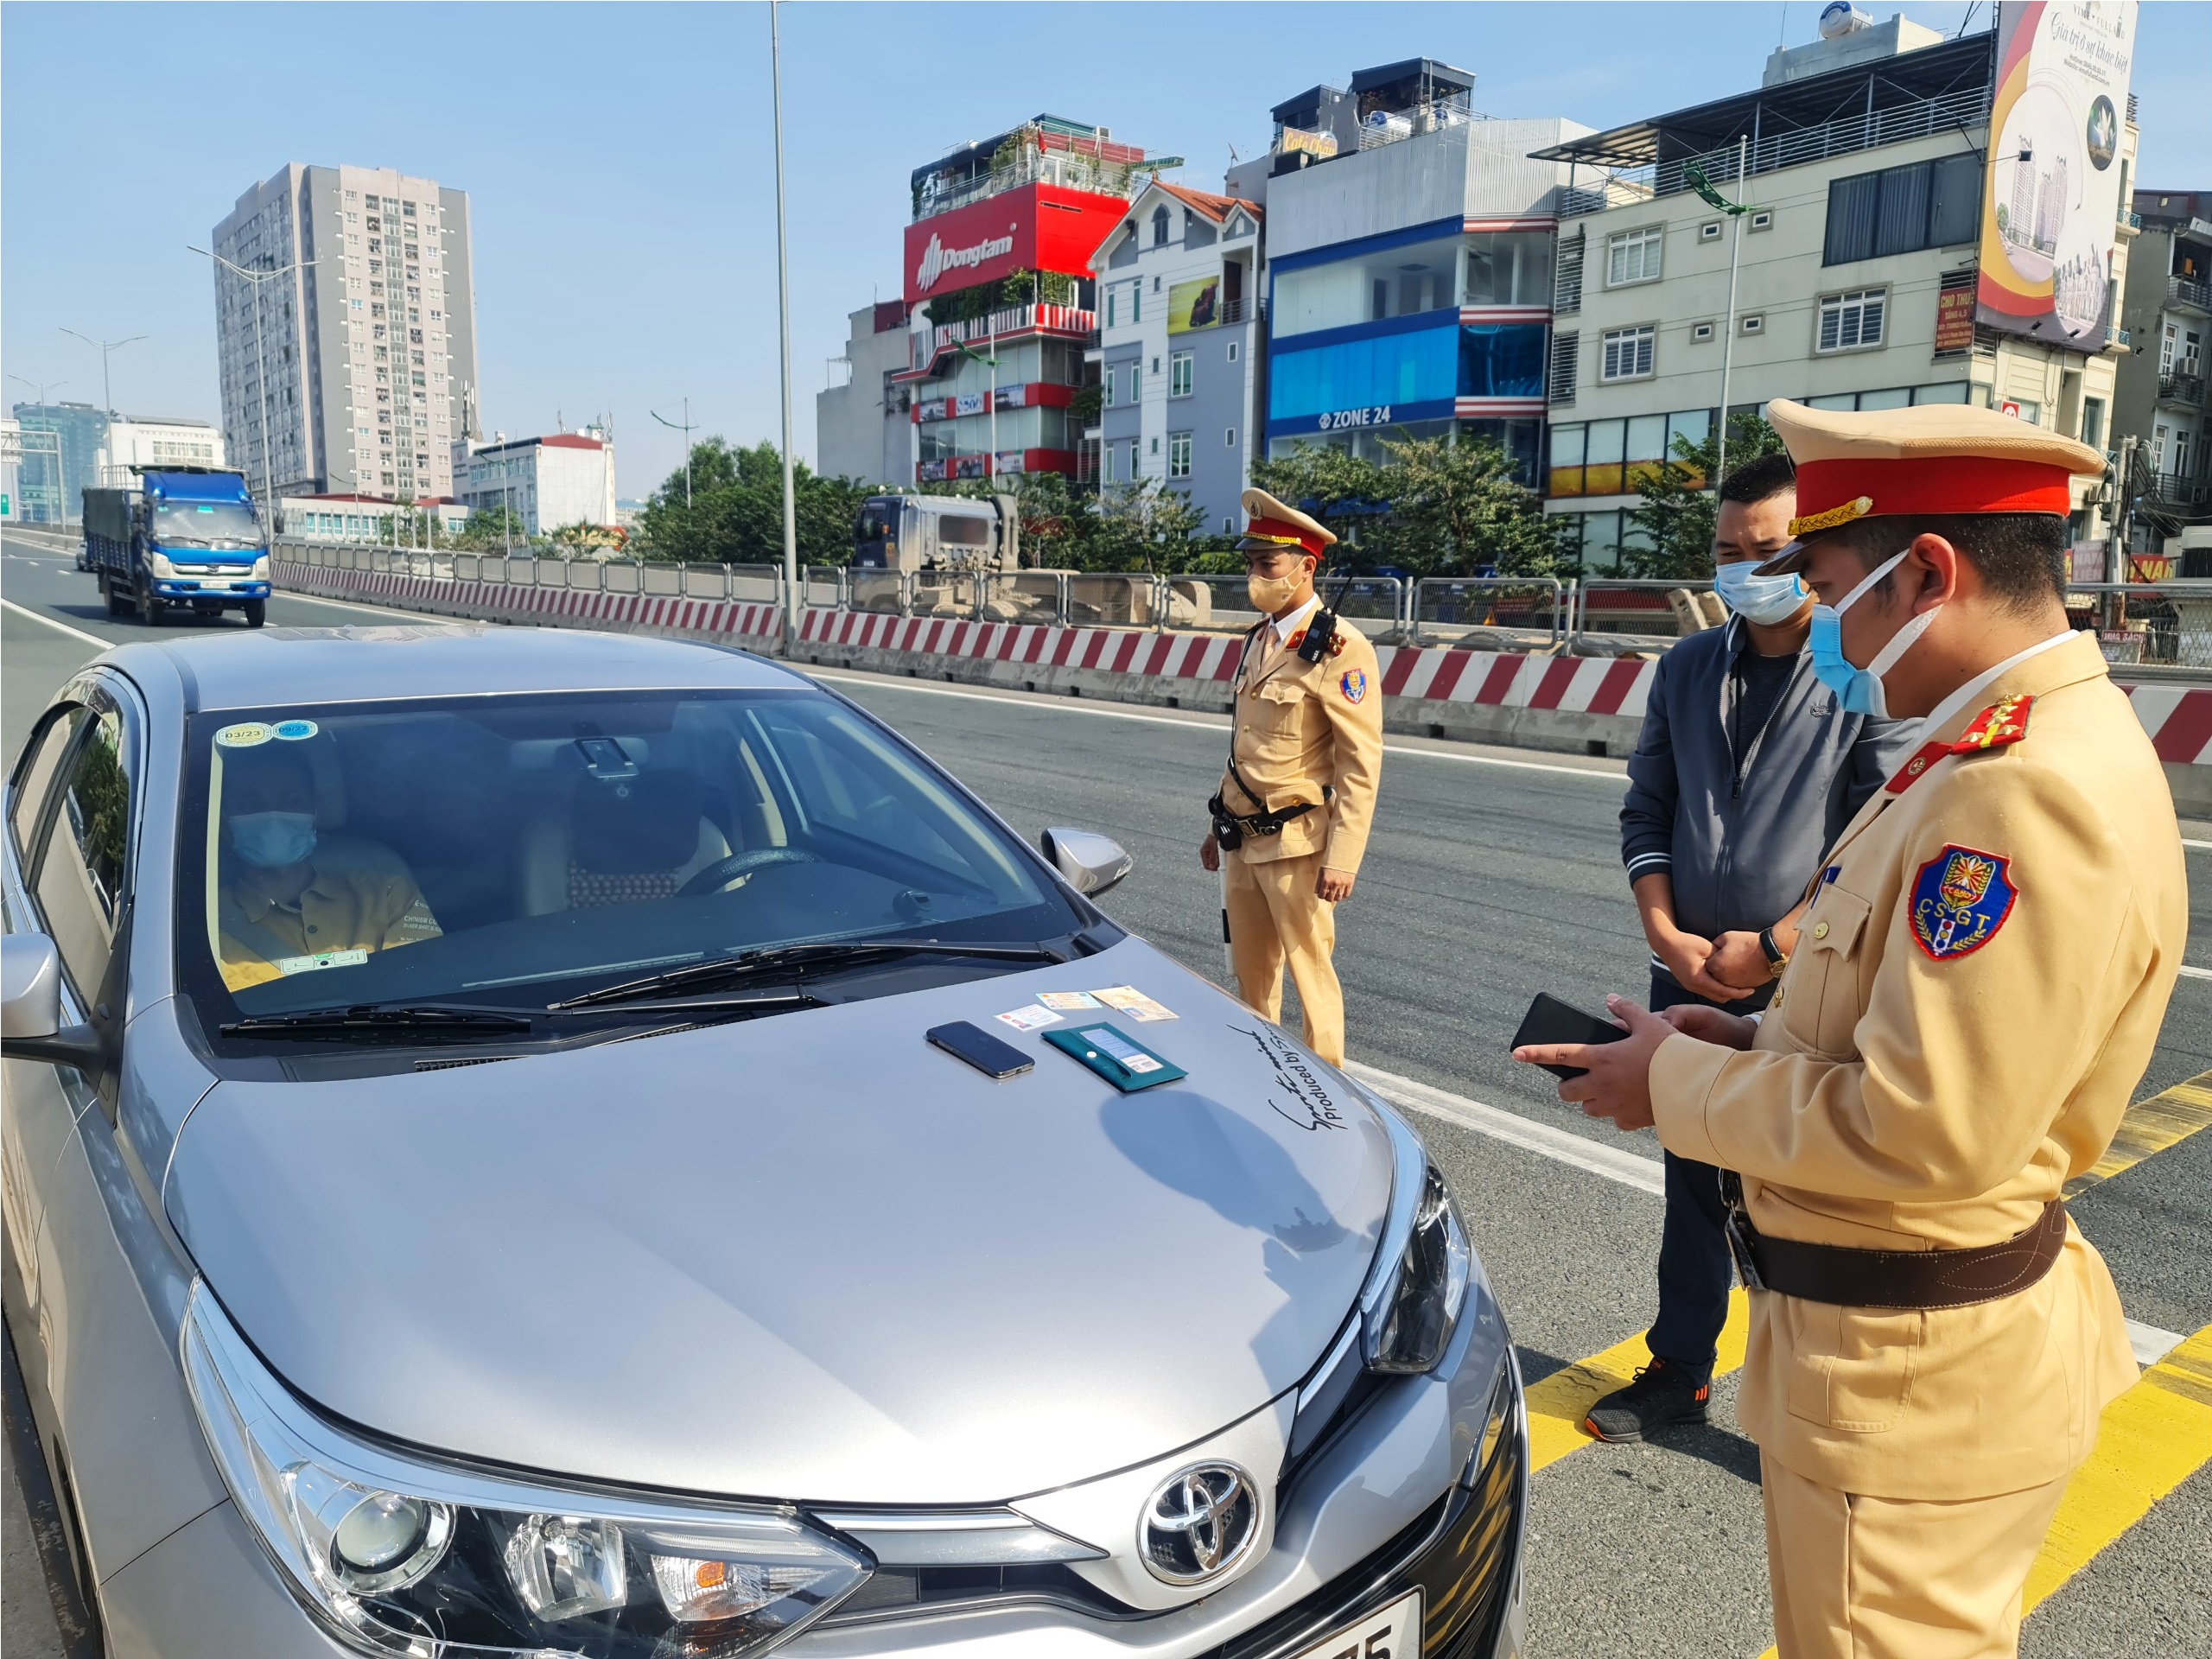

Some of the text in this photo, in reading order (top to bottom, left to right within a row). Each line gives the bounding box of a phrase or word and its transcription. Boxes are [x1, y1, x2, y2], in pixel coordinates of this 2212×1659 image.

[1332, 405, 1390, 429] ZONE 24
[1919, 898, 1991, 930] CSGT
[1281, 1050, 1300, 1064] by
[1289, 1065, 1343, 1120] Produced
